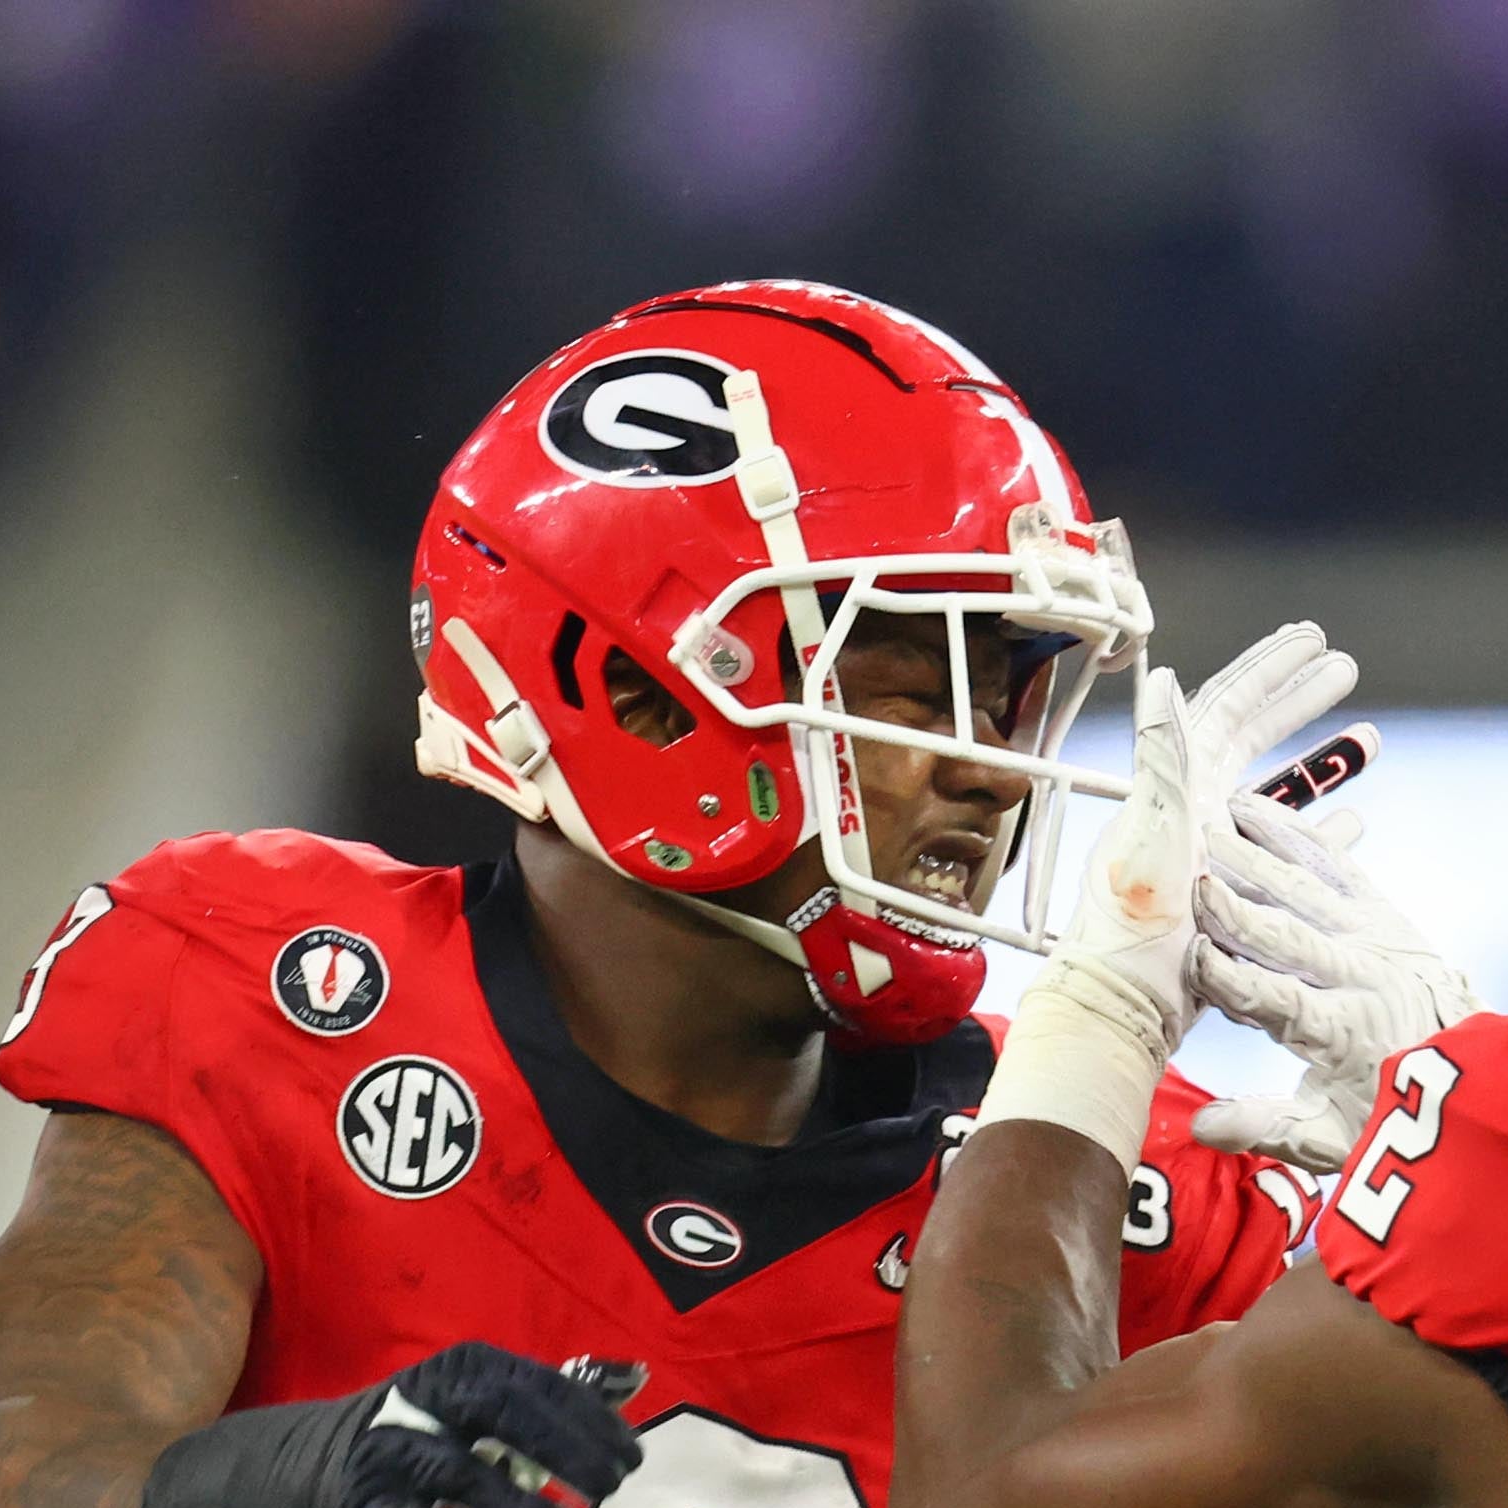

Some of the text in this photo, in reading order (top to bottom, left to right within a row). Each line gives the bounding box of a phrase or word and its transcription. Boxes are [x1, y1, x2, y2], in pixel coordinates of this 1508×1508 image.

[539, 349, 743, 488] G
[351, 1066, 470, 1187] SEC
[1335, 1046, 1462, 1243] 2
[647, 1202, 744, 1268] G
